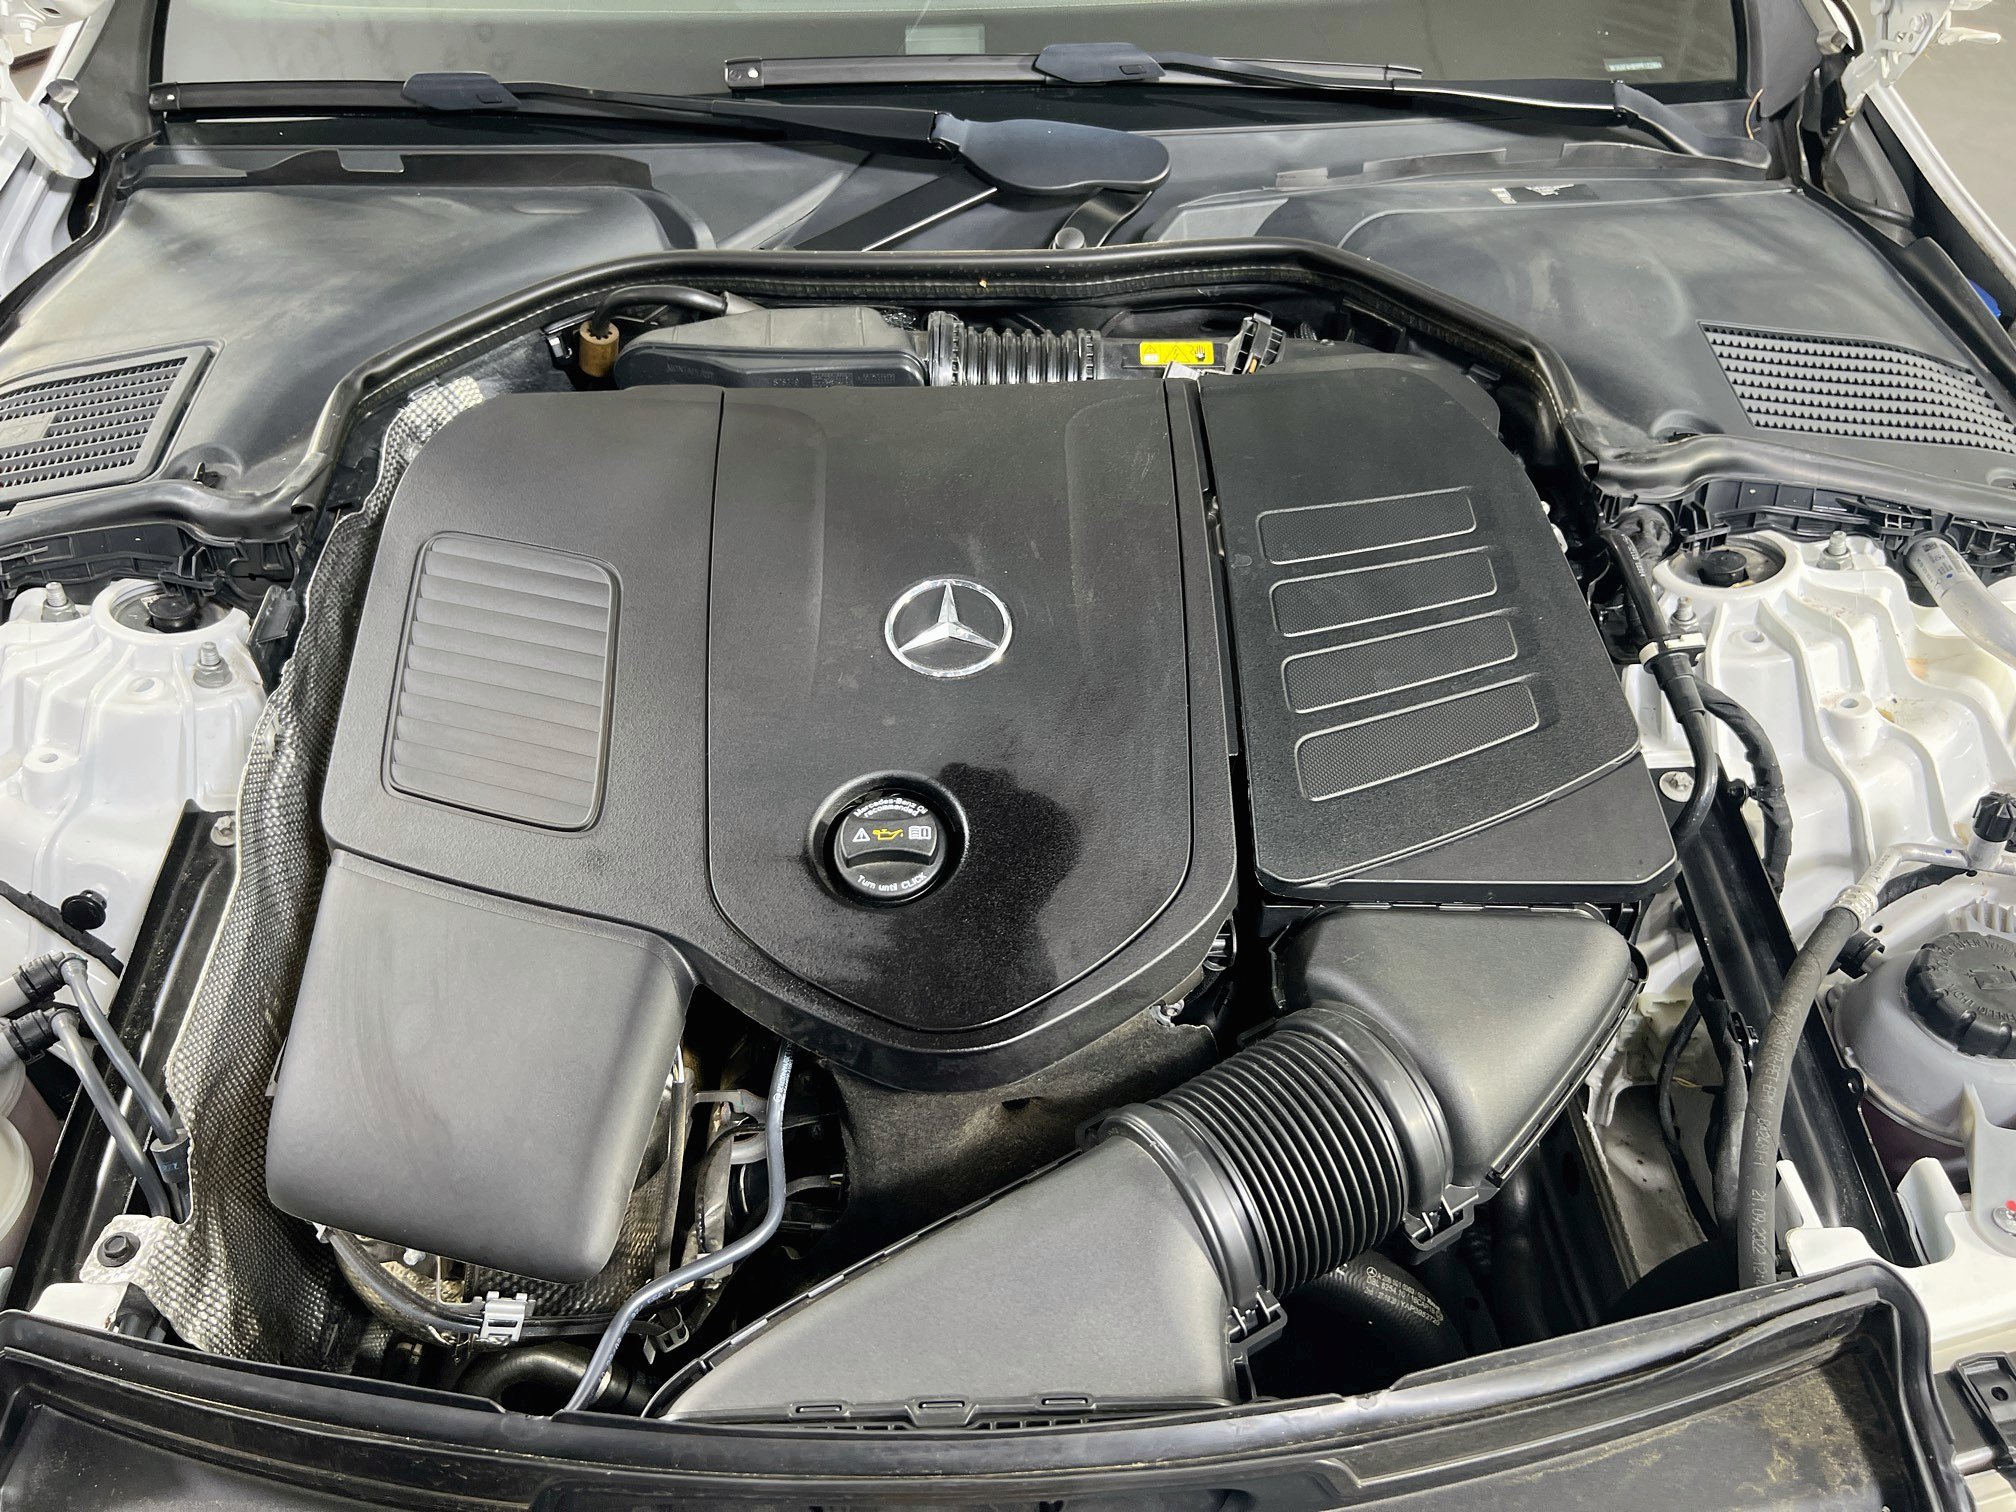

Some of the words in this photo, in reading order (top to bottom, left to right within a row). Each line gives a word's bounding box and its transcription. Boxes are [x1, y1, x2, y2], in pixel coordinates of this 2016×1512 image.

[853, 797, 917, 817] Mercedes-Benz
[916, 805, 928, 815] Oil
[864, 804, 920, 818] recommended
[857, 874, 876, 889] Turn
[878, 882, 898, 892] until
[901, 871, 927, 889] CLICK
[1751, 1188, 1767, 1255] 21.09.2022
